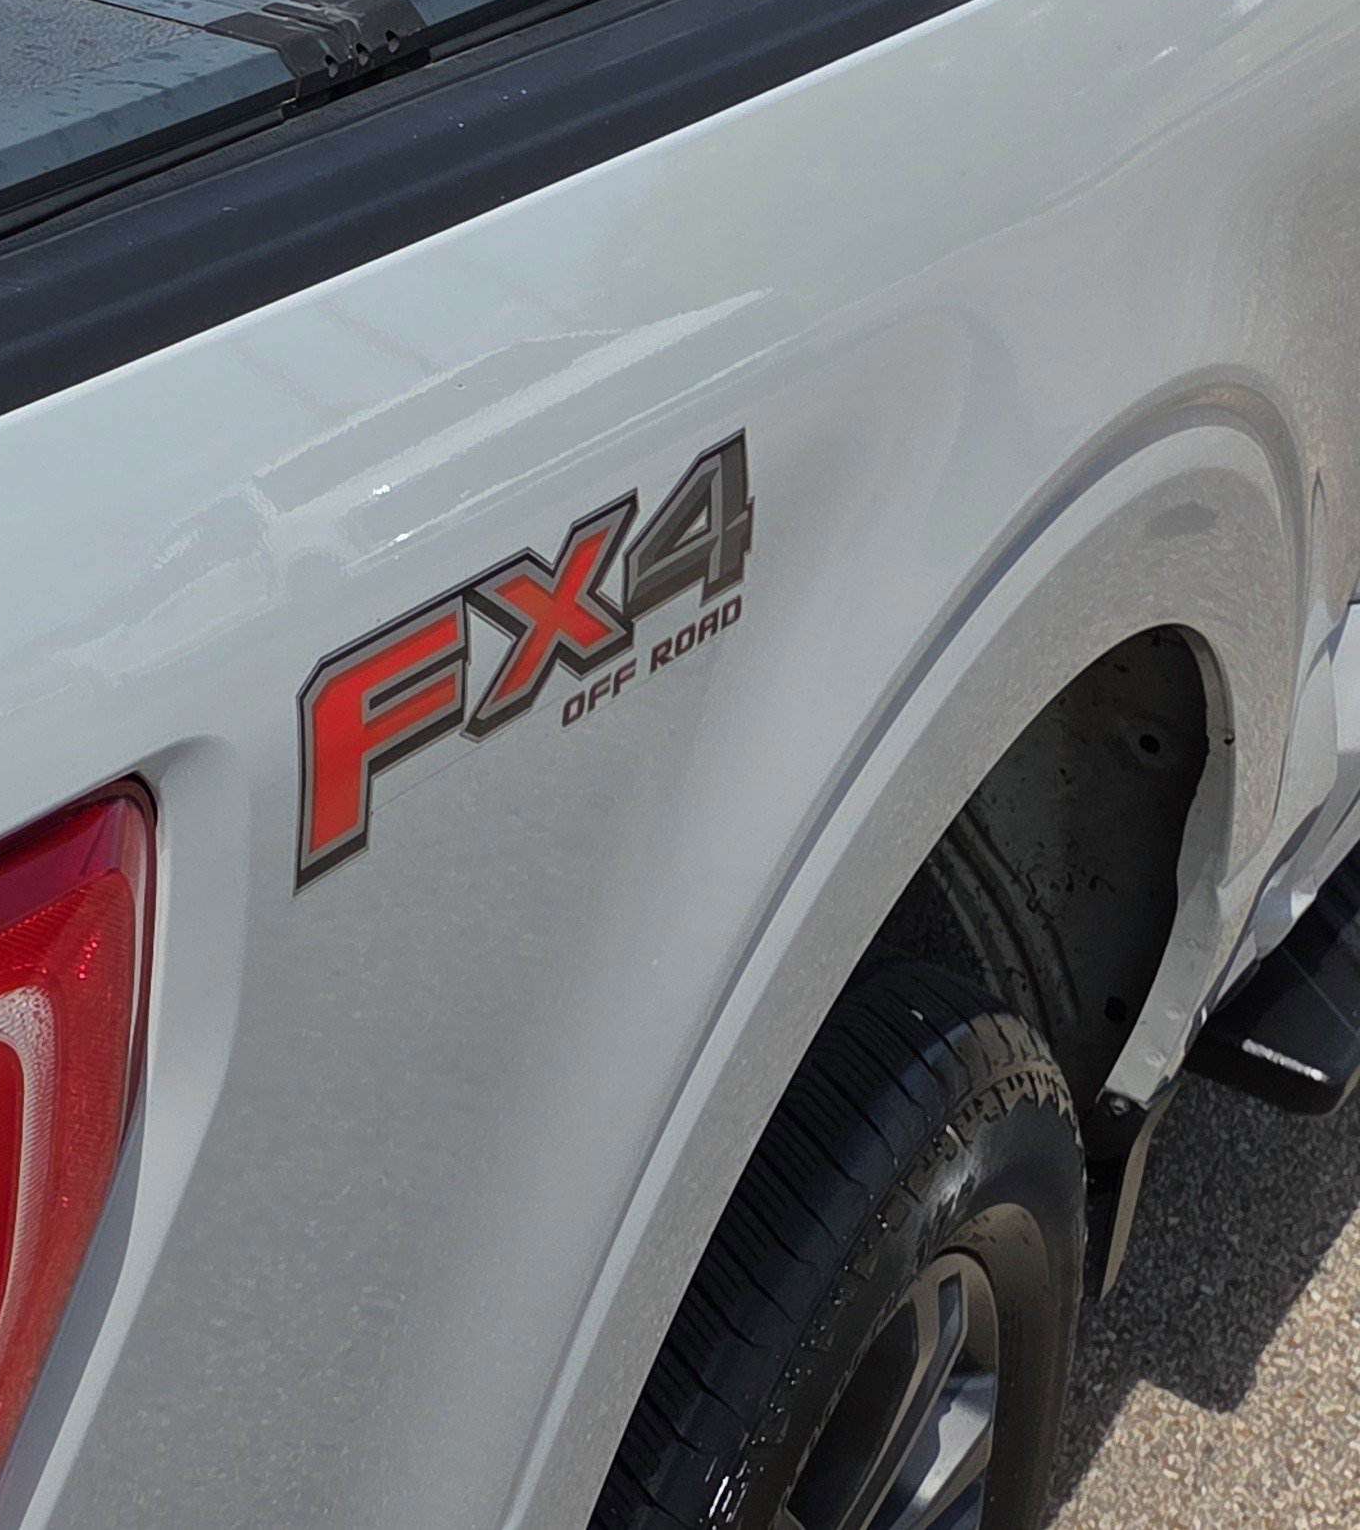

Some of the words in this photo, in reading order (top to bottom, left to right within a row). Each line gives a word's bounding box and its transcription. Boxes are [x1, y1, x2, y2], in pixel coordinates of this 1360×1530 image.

[292, 426, 755, 898] FX4
[562, 657, 637, 728] OFF
[649, 594, 743, 676] ROAD
